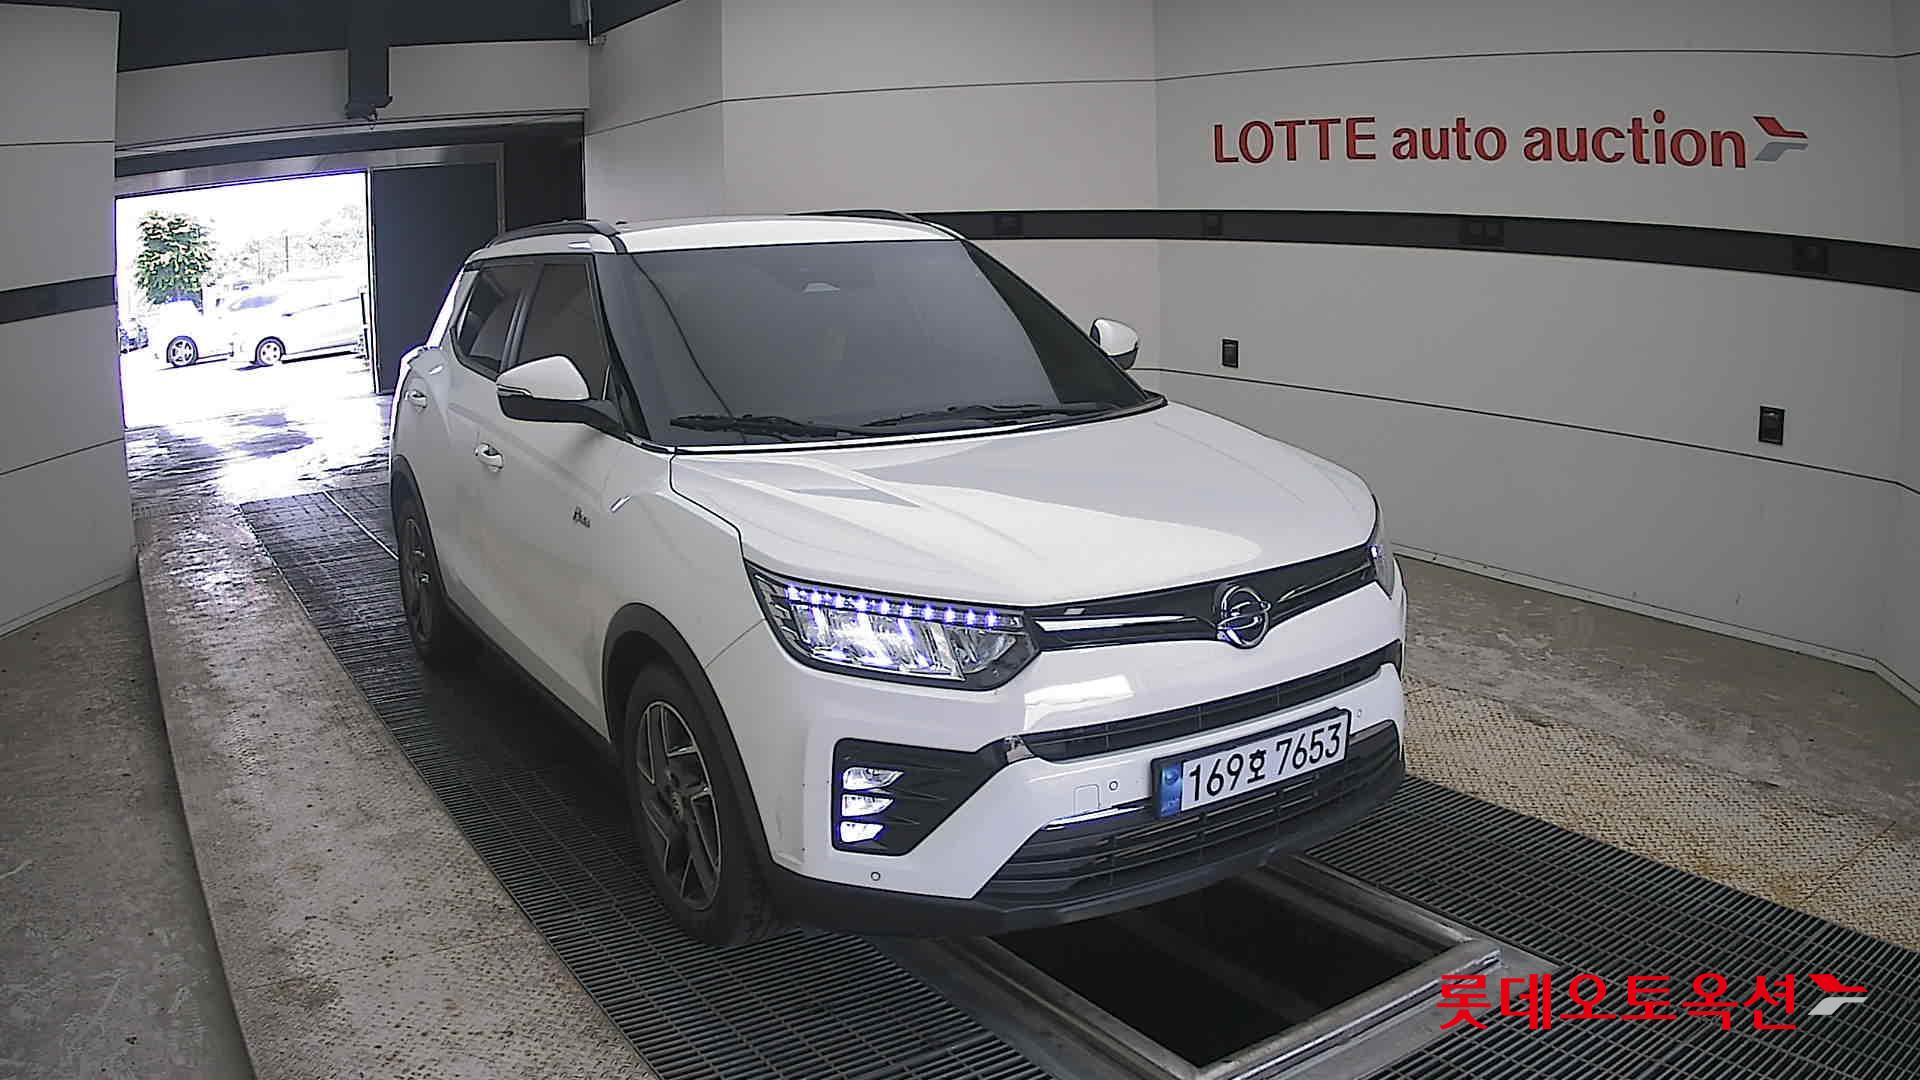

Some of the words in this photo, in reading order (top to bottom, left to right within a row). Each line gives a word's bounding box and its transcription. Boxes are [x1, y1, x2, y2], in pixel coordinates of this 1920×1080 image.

[1213, 117, 1376, 163] LOTTE
[1392, 117, 1508, 162] auto
[1522, 109, 1747, 168] auction
[1189, 749, 1267, 801] 169호
[1276, 722, 1342, 775] 7653
